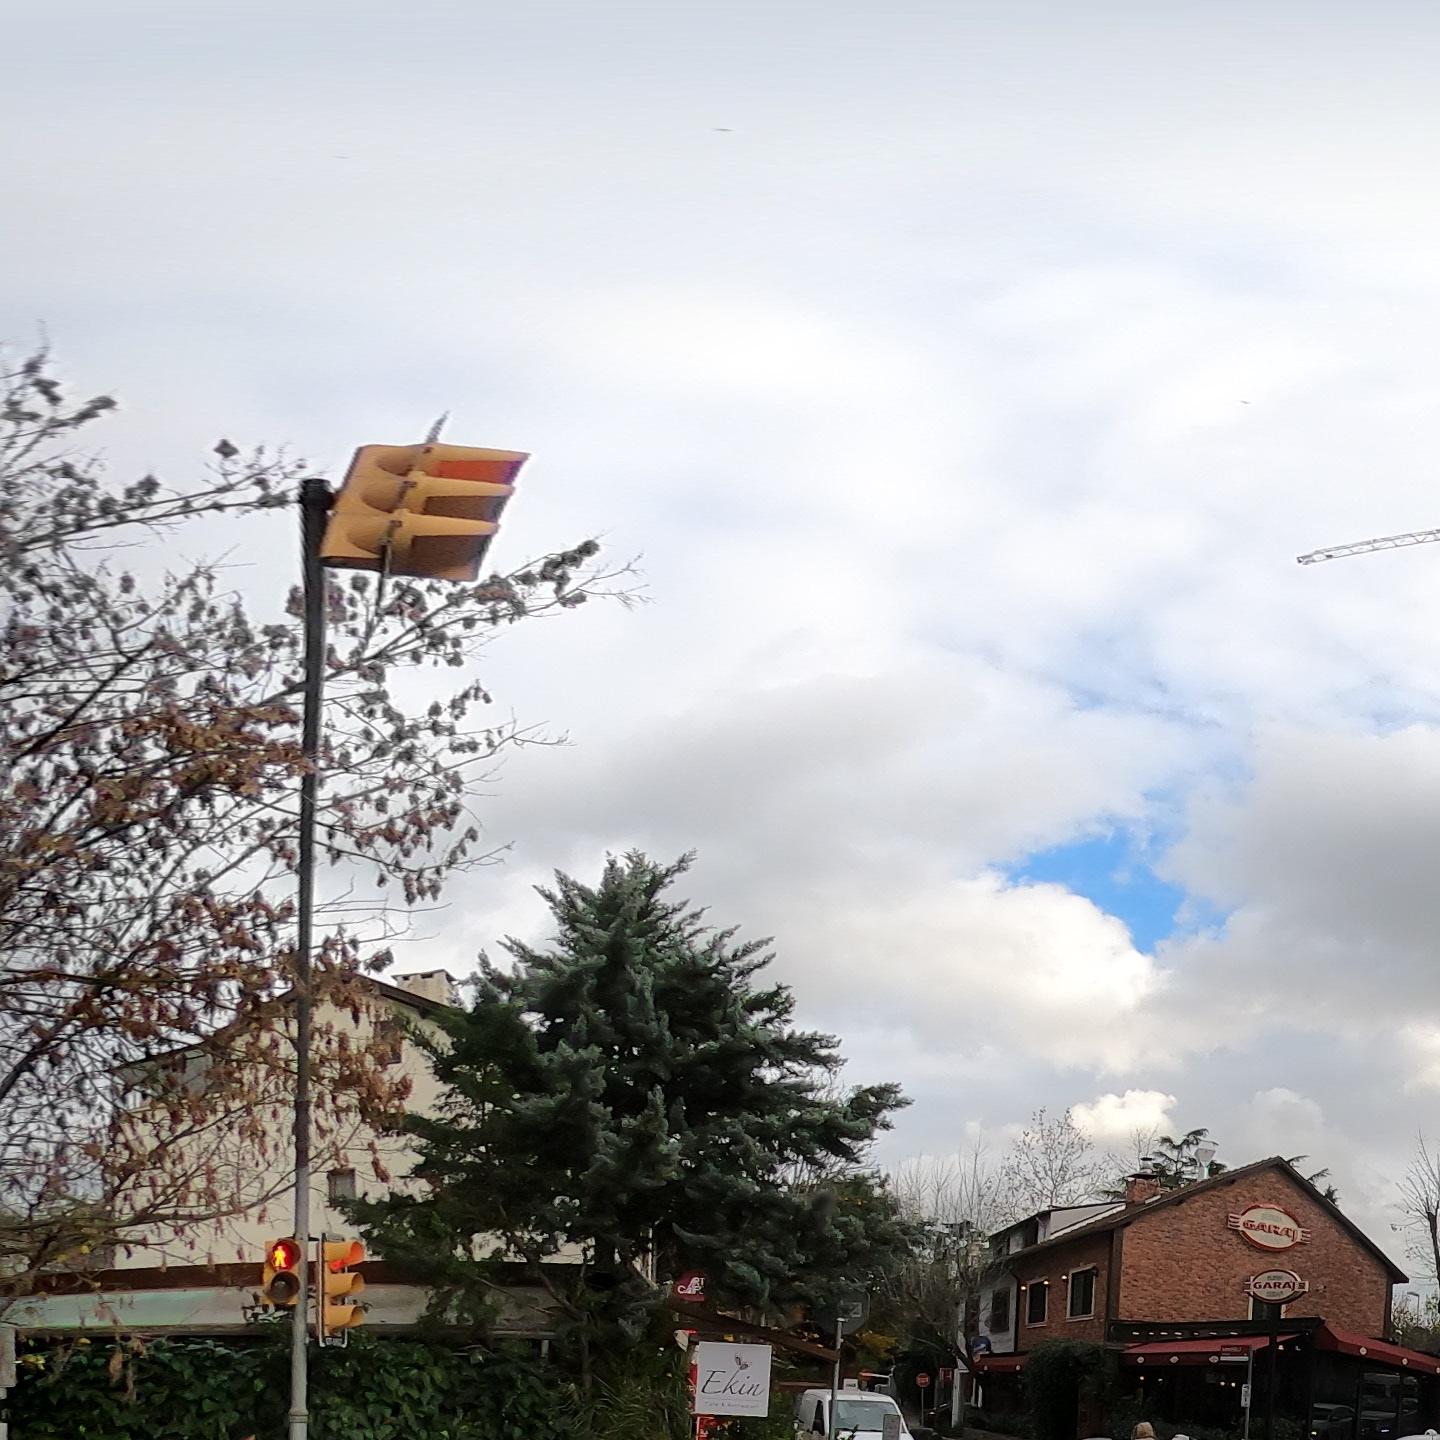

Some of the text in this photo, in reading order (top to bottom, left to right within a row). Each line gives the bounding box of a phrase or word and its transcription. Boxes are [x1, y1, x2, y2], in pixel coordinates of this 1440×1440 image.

[1243, 1220, 1297, 1242] GARAJ
[1253, 1281, 1296, 1292] GARAJ
[701, 1368, 765, 1397] Ekin
